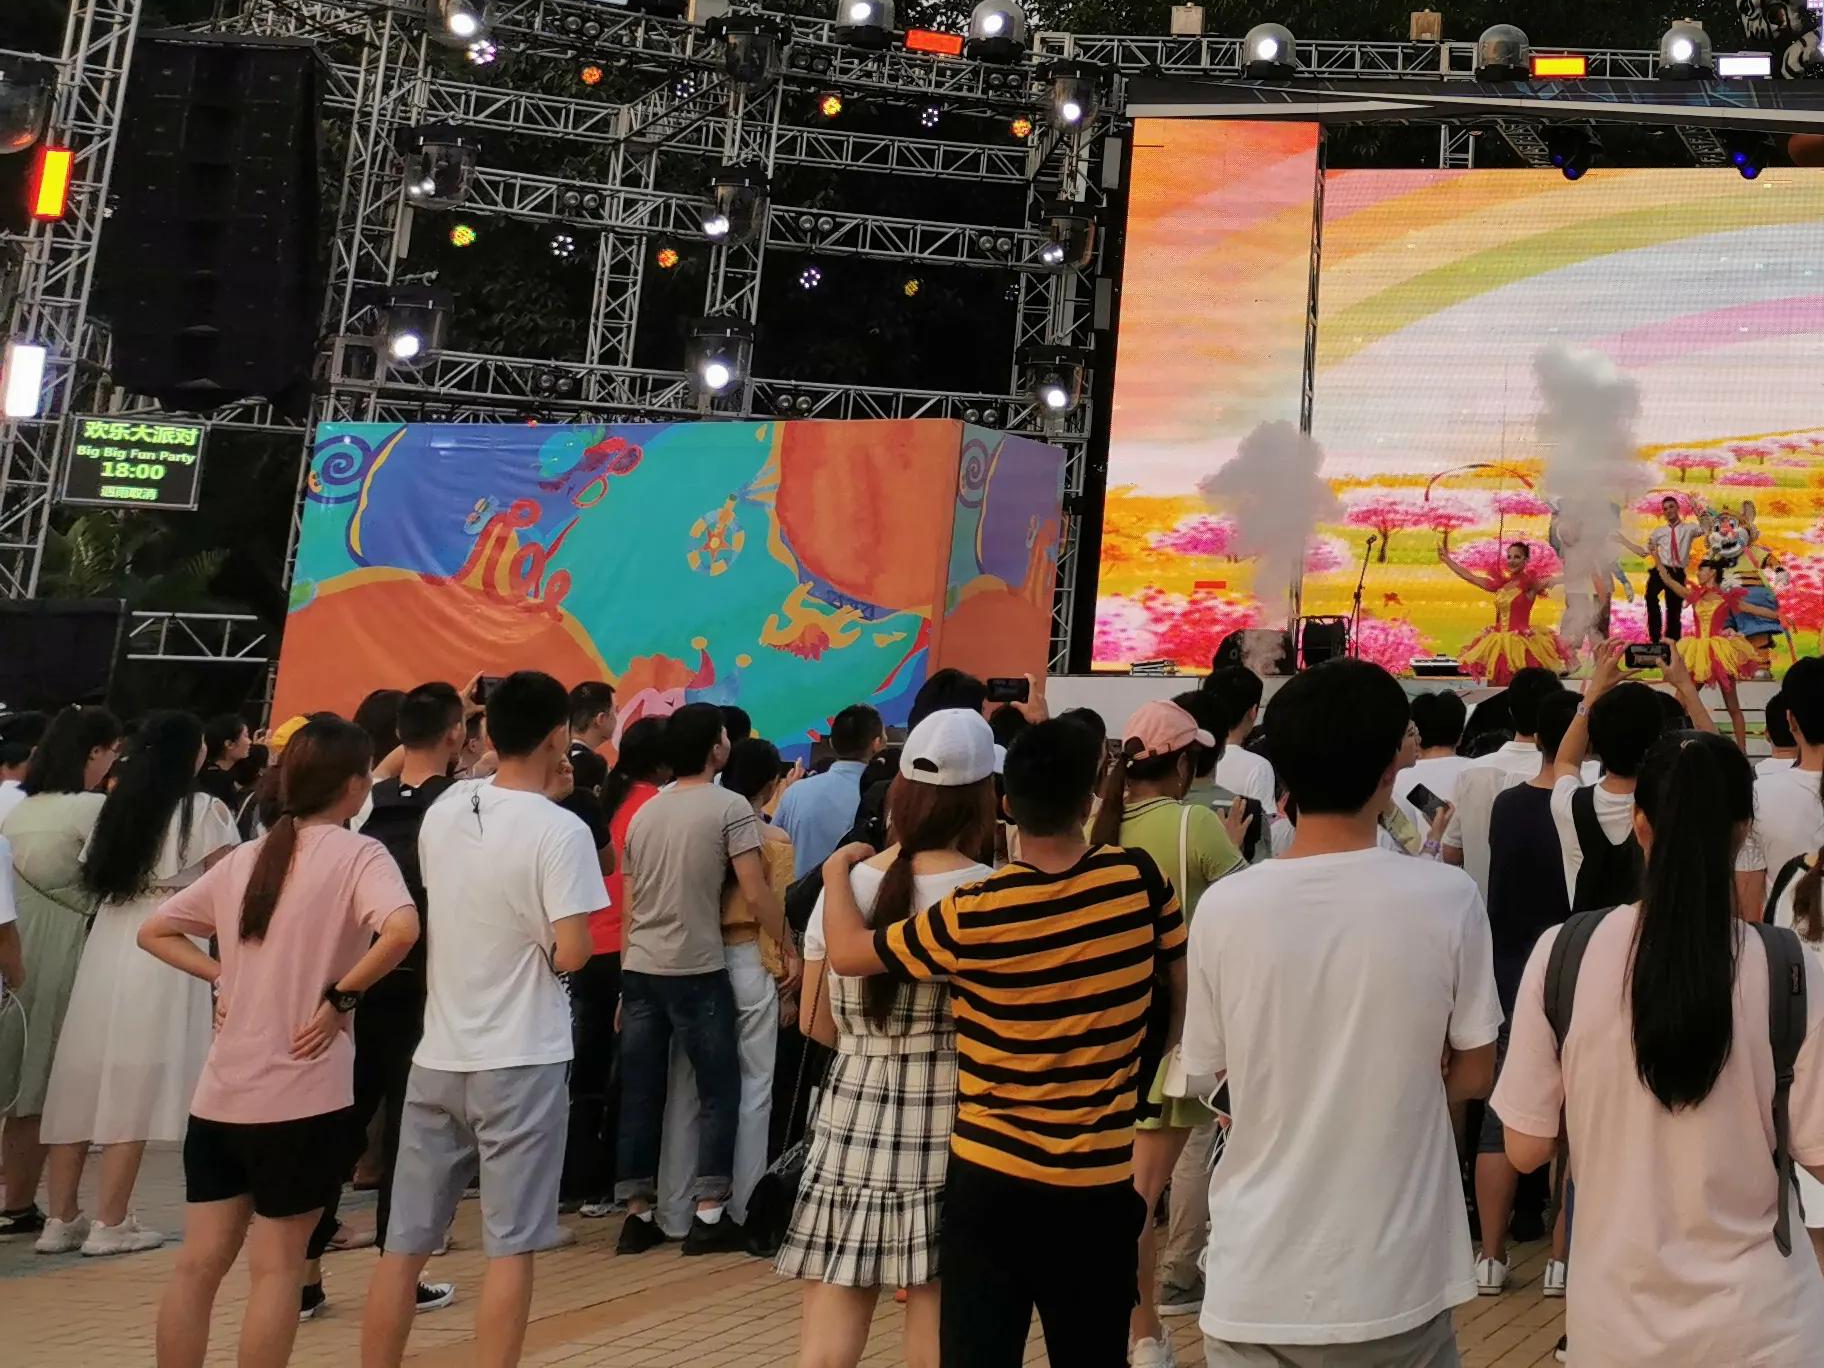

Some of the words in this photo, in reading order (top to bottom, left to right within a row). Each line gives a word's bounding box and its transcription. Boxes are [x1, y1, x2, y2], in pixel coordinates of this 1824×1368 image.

[84, 421, 199, 445] 欢乐大派对
[76, 444, 101, 458] Big
[103, 447, 127, 460] Big
[130, 449, 156, 460] Fun
[160, 451, 196, 465] Party
[100, 461, 165, 480] 18:00
